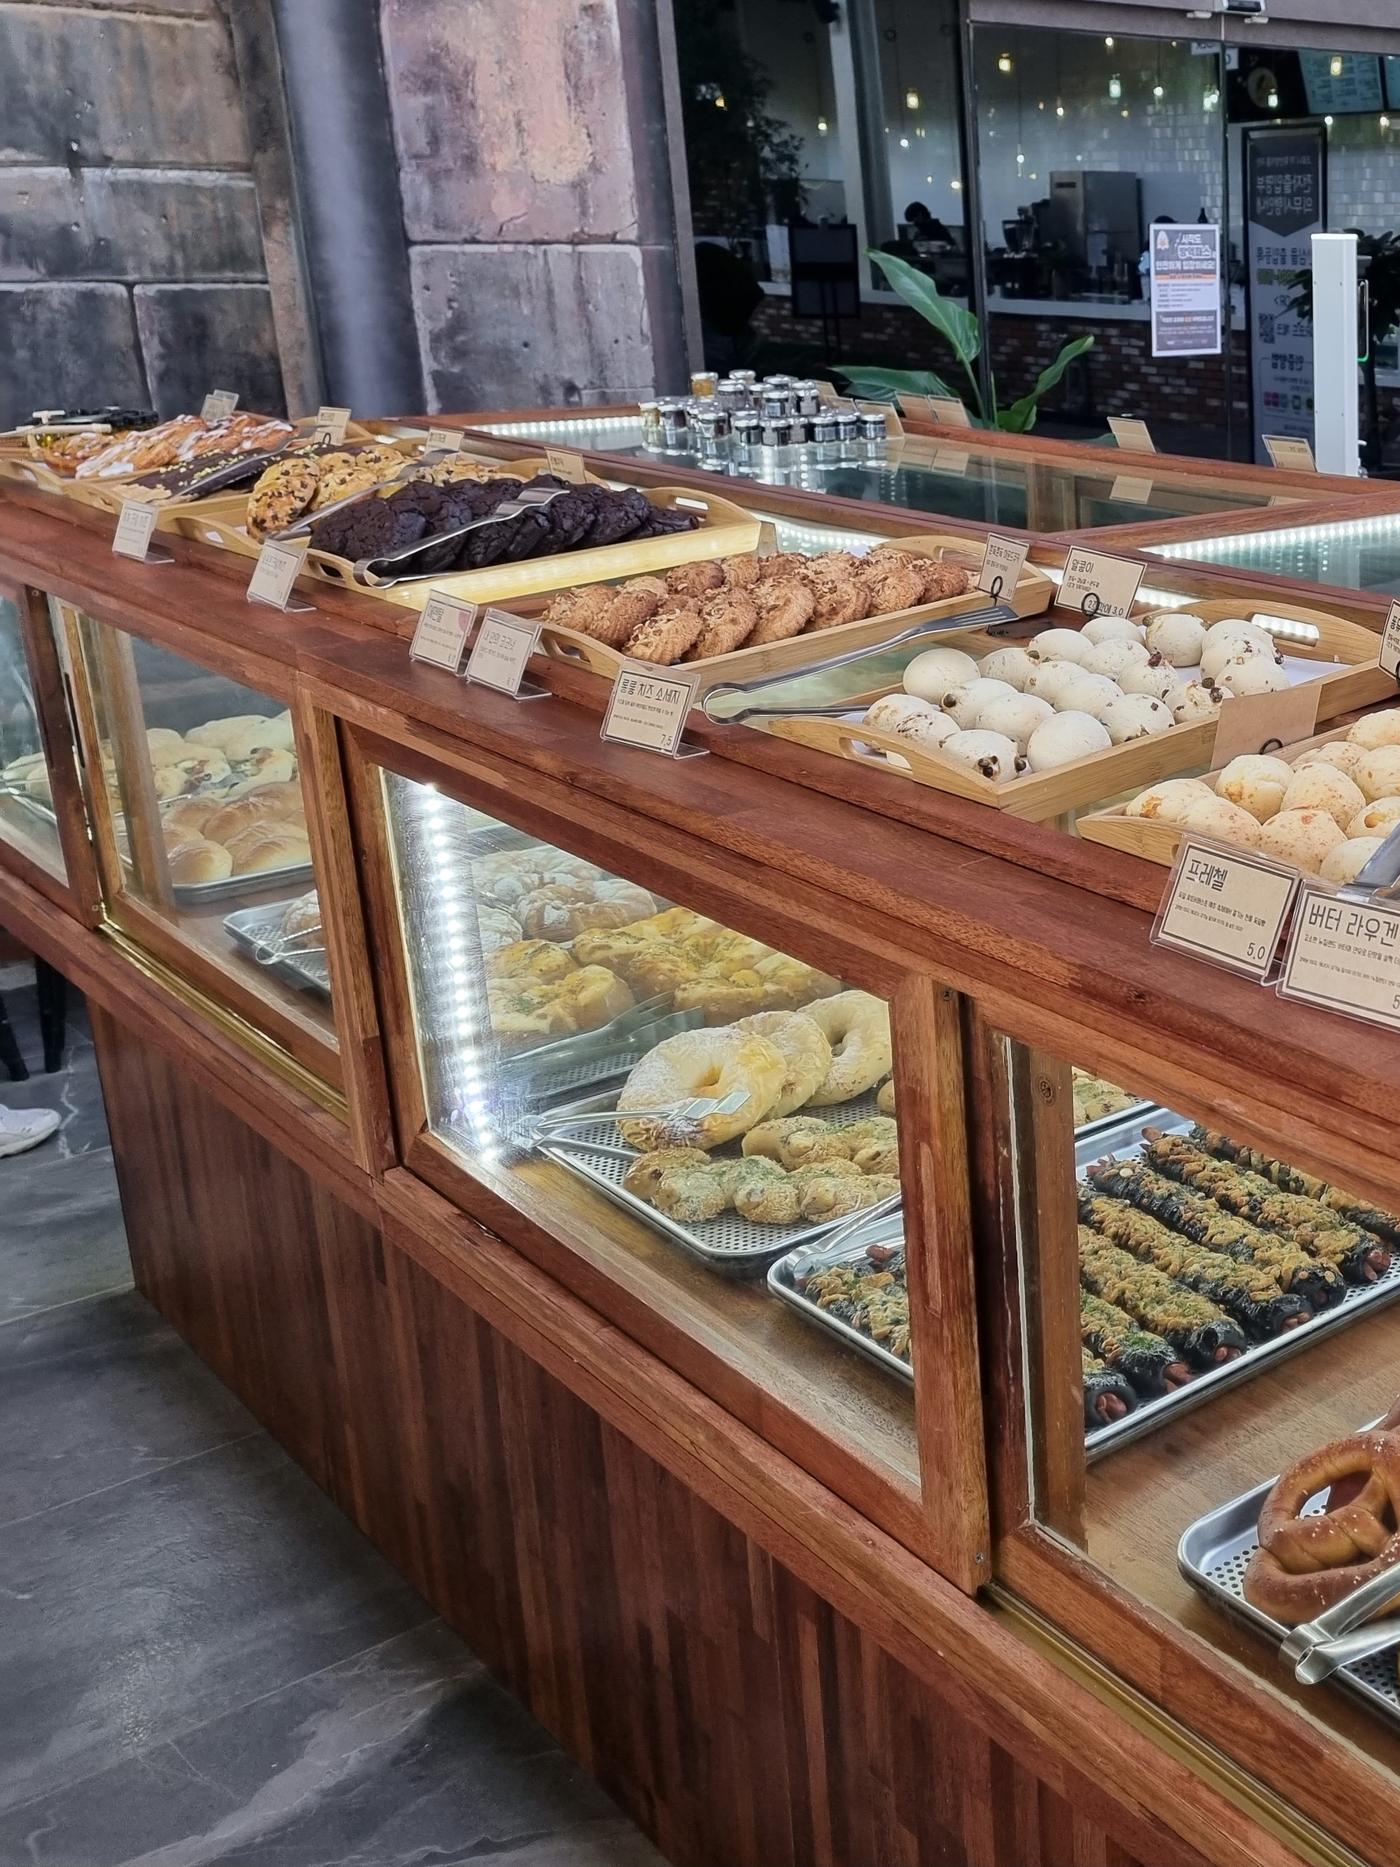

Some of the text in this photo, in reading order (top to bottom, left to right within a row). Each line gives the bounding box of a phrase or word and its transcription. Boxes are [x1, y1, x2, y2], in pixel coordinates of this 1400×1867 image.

[661, 733, 673, 747] 7.5
[1185, 859, 1228, 892] 프레첼
[1308, 904, 1399, 947] 버터 라우겐
[1246, 942, 1266, 960] 5.0
